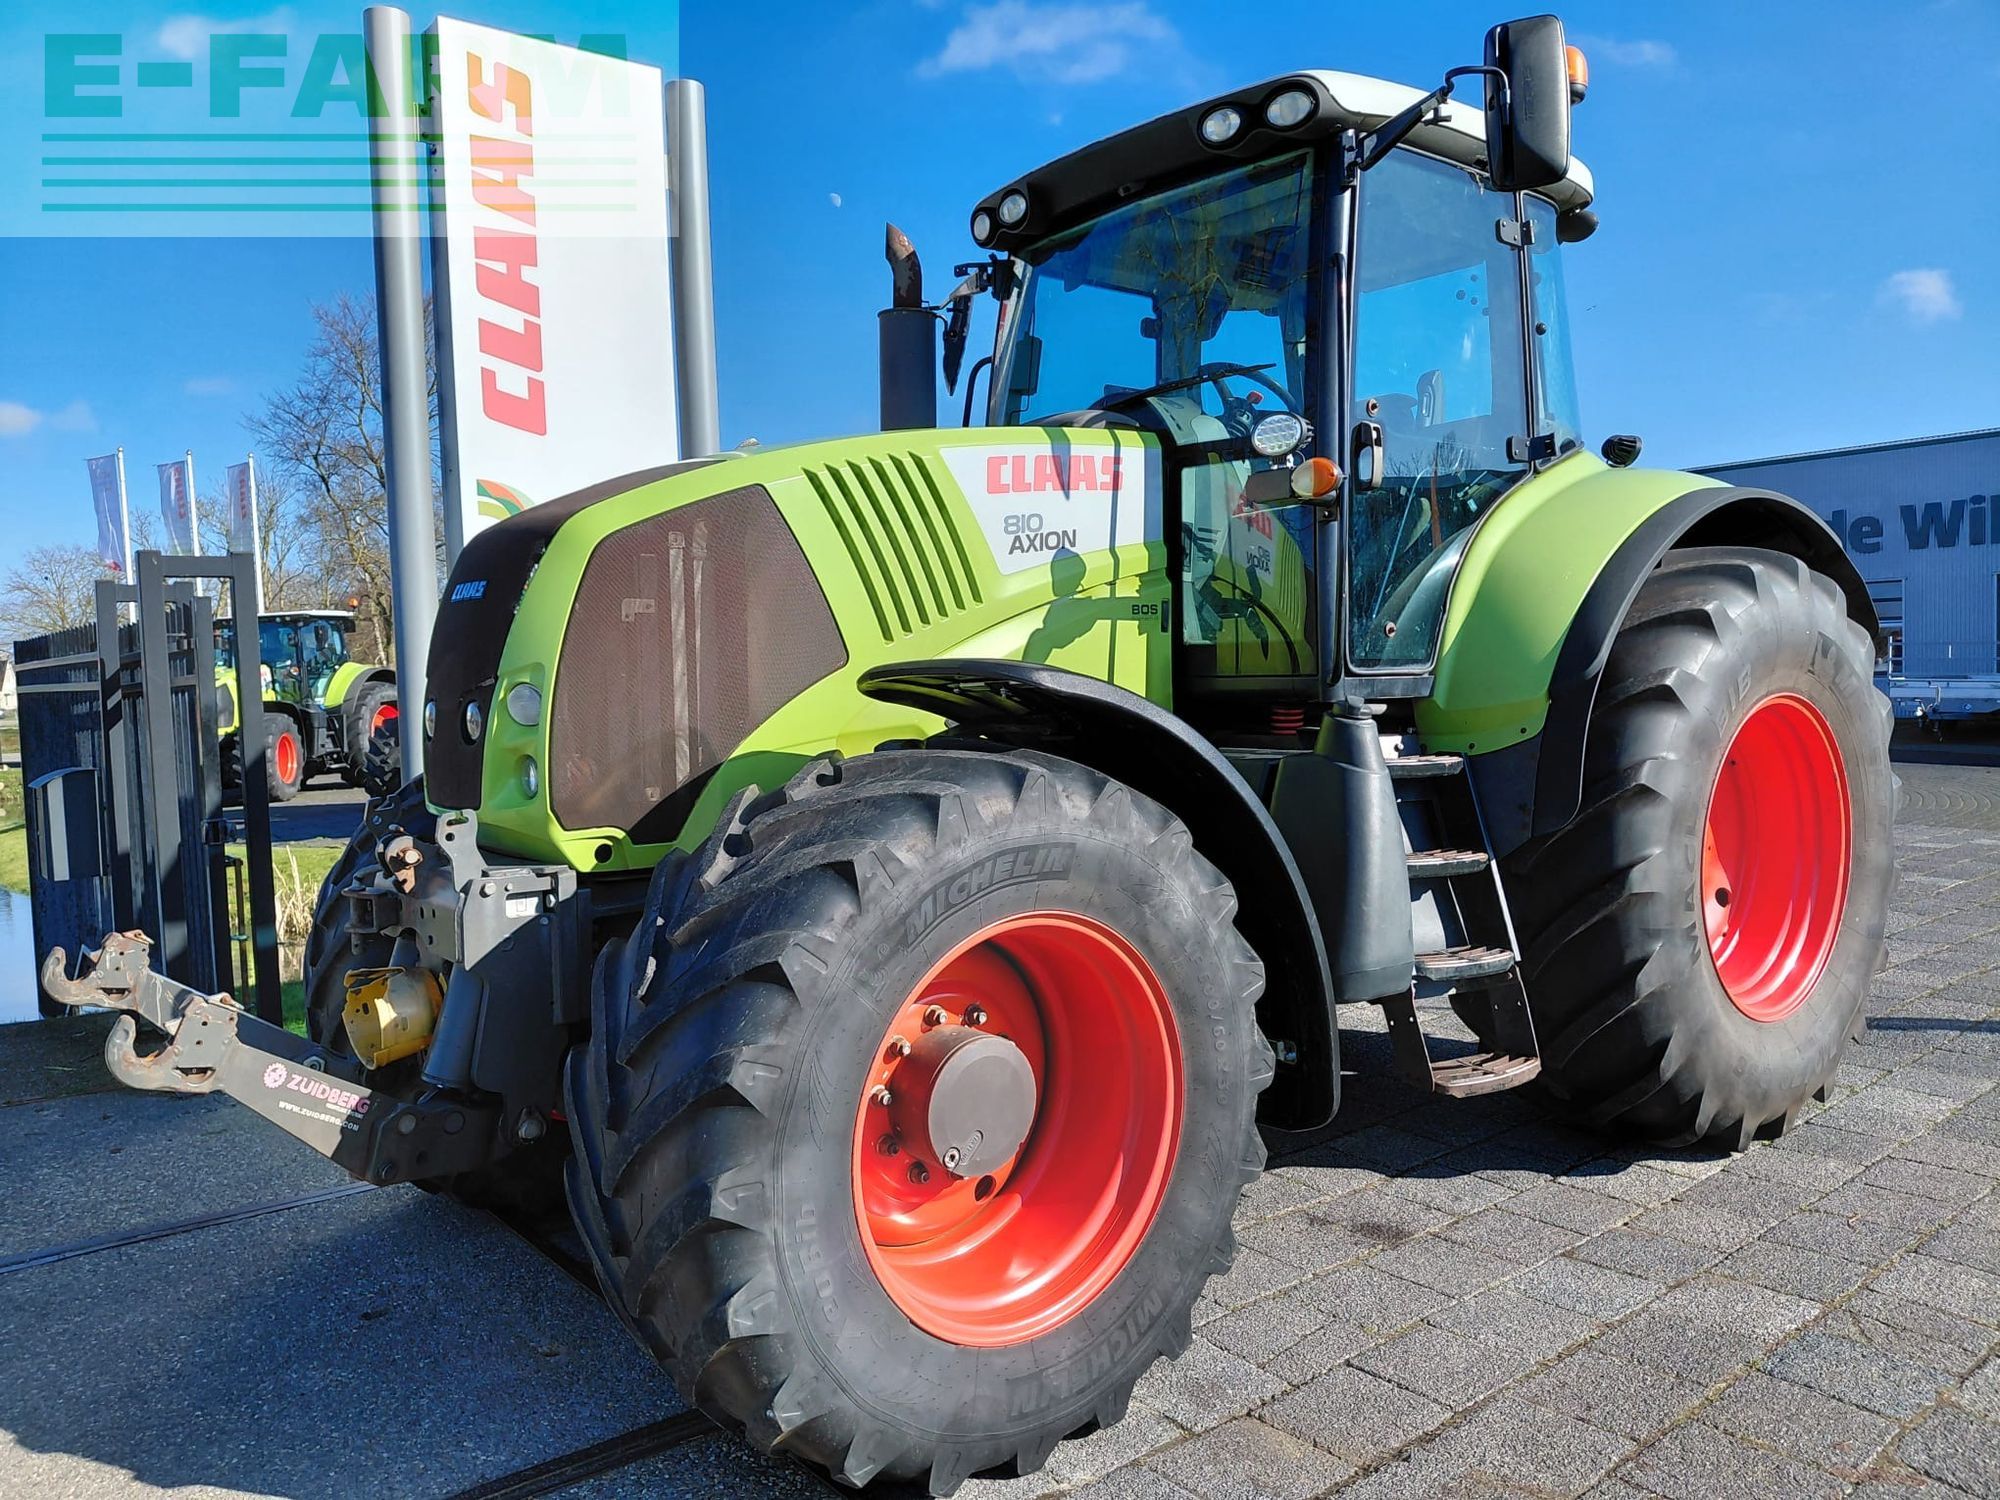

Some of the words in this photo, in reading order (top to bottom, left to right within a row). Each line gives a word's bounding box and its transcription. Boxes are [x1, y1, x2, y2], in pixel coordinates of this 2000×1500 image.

[466, 51, 547, 436] CLAAS
[986, 455, 1124, 494] CLAAS
[1003, 513, 1043, 535] 810
[1008, 529, 1077, 555] AXION
[904, 845, 1071, 943] MICHELIN
[286, 1073, 371, 1114] ZUIDBERG
